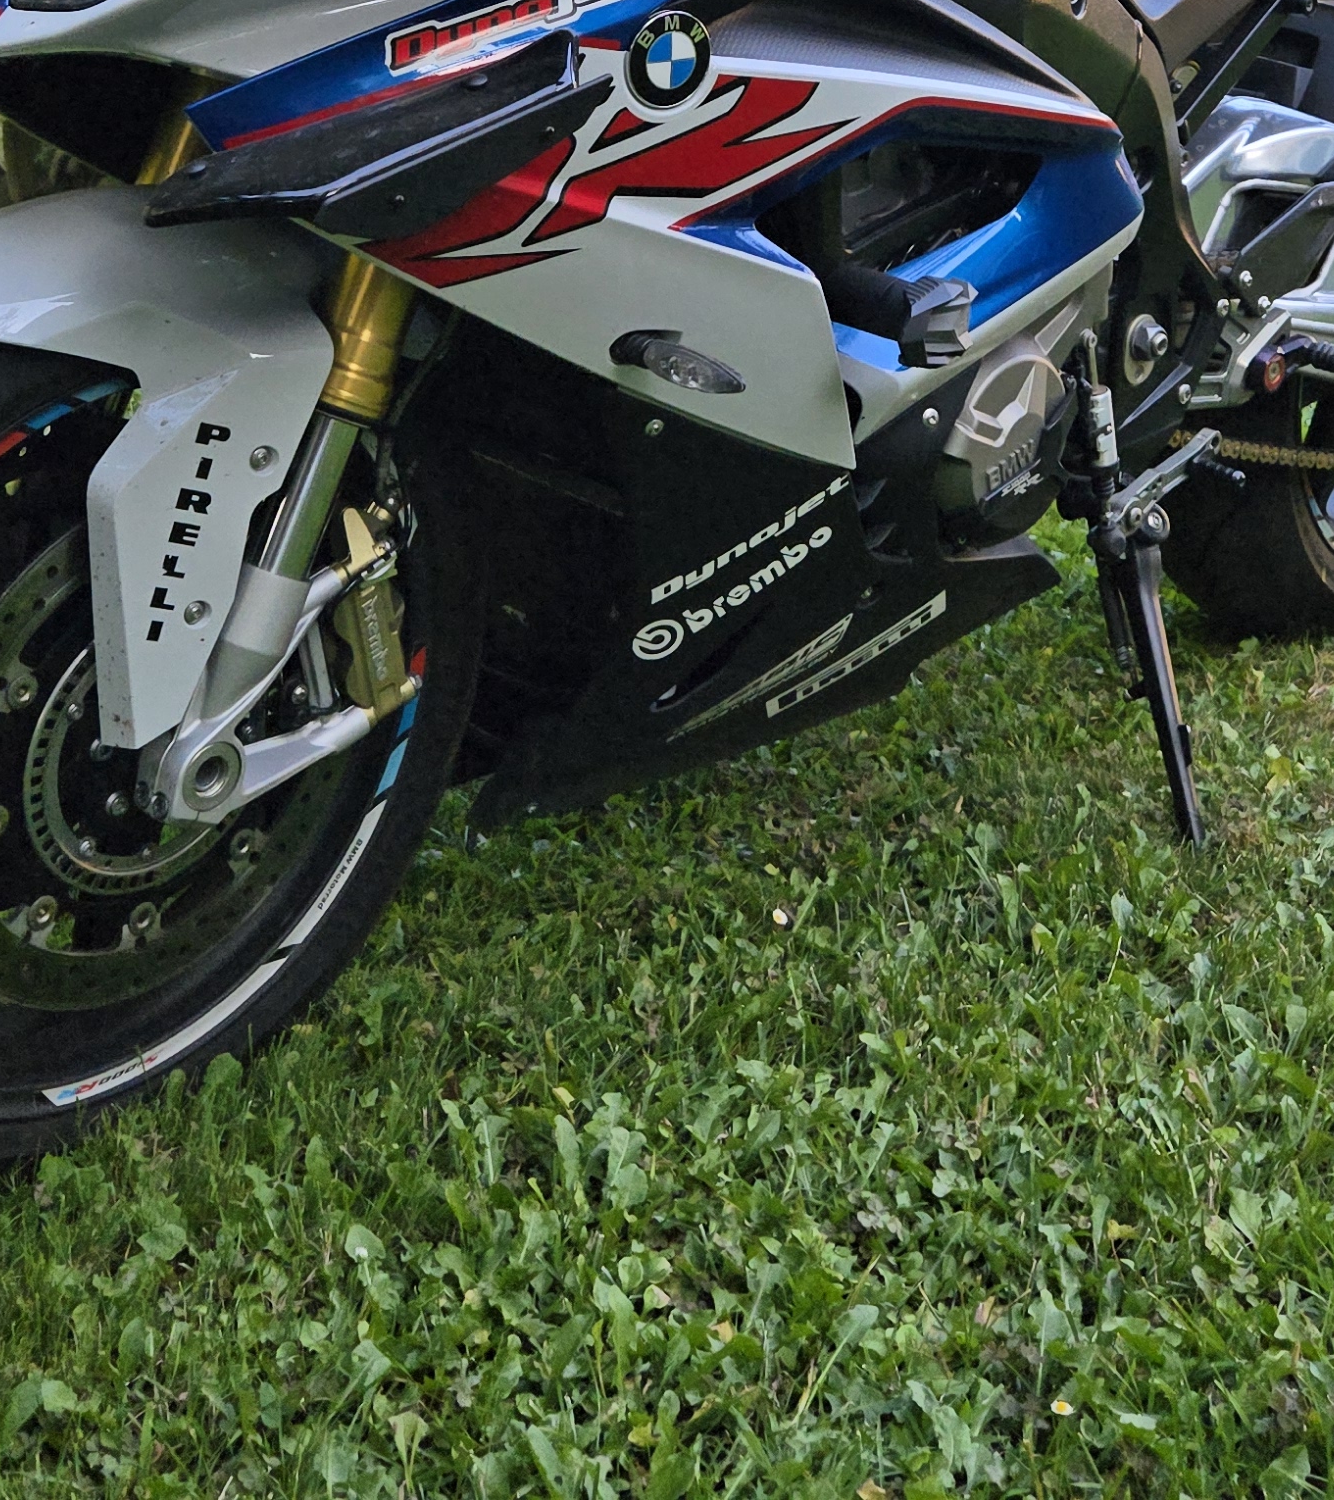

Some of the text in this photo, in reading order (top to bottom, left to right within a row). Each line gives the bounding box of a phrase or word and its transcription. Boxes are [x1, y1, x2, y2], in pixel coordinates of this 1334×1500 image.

[638, 13, 707, 51] BMW
[986, 438, 1035, 491] BMW
[146, 421, 231, 642] PIRELLI
[650, 471, 851, 605] Dynojet
[681, 525, 833, 634] brembo
[776, 602, 935, 710] PIRELLI
[317, 838, 364, 911] BMW Motorrad
